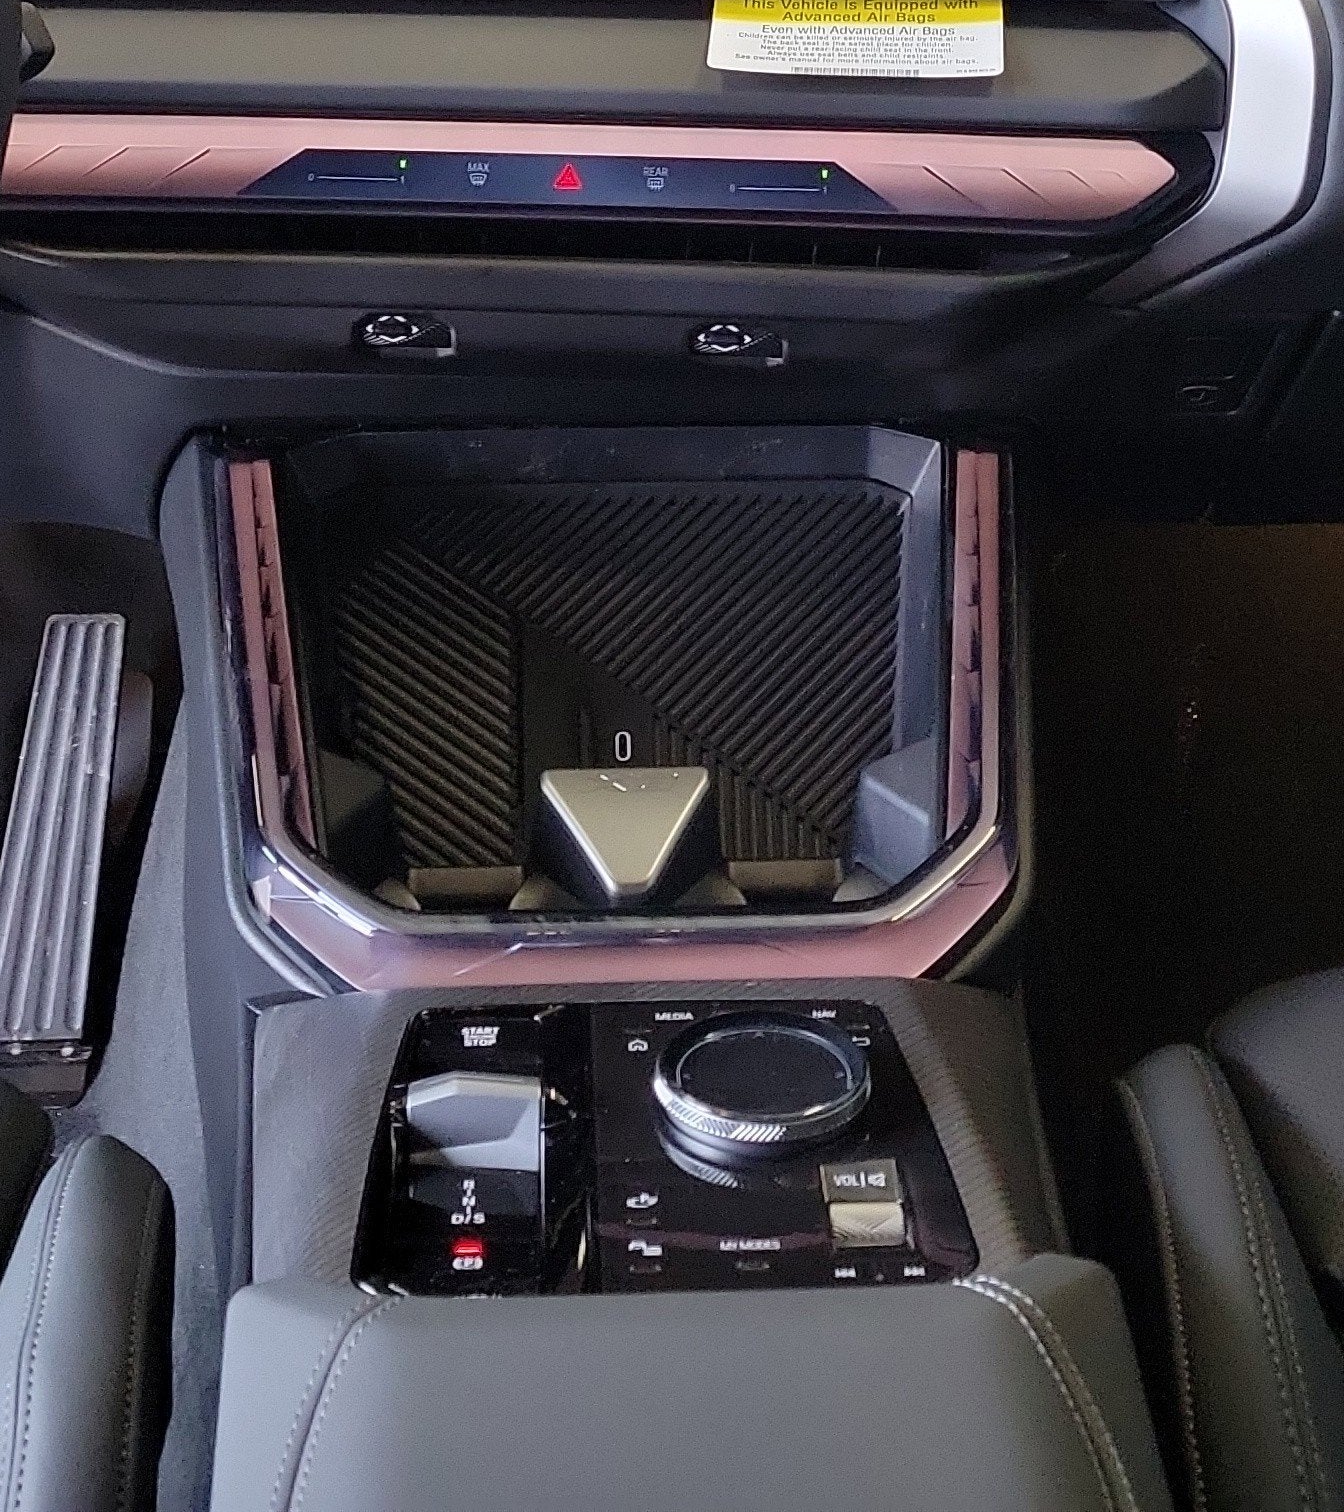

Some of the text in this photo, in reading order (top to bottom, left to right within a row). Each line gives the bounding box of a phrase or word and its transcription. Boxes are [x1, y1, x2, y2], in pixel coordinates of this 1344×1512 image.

[781, 0, 838, 10] Vehicle
[844, 0, 857, 10] is
[863, 0, 938, 12] Equipped
[944, 0, 978, 9] with
[782, 11, 936, 24] Advanced Air Bags
[762, 25, 955, 37] Even with Advanced Air Bags
[467, 161, 490, 172] MAX
[643, 167, 669, 177] REAR
[654, 1011, 694, 1021] MEDIA
[812, 1009, 837, 1019] NAV
